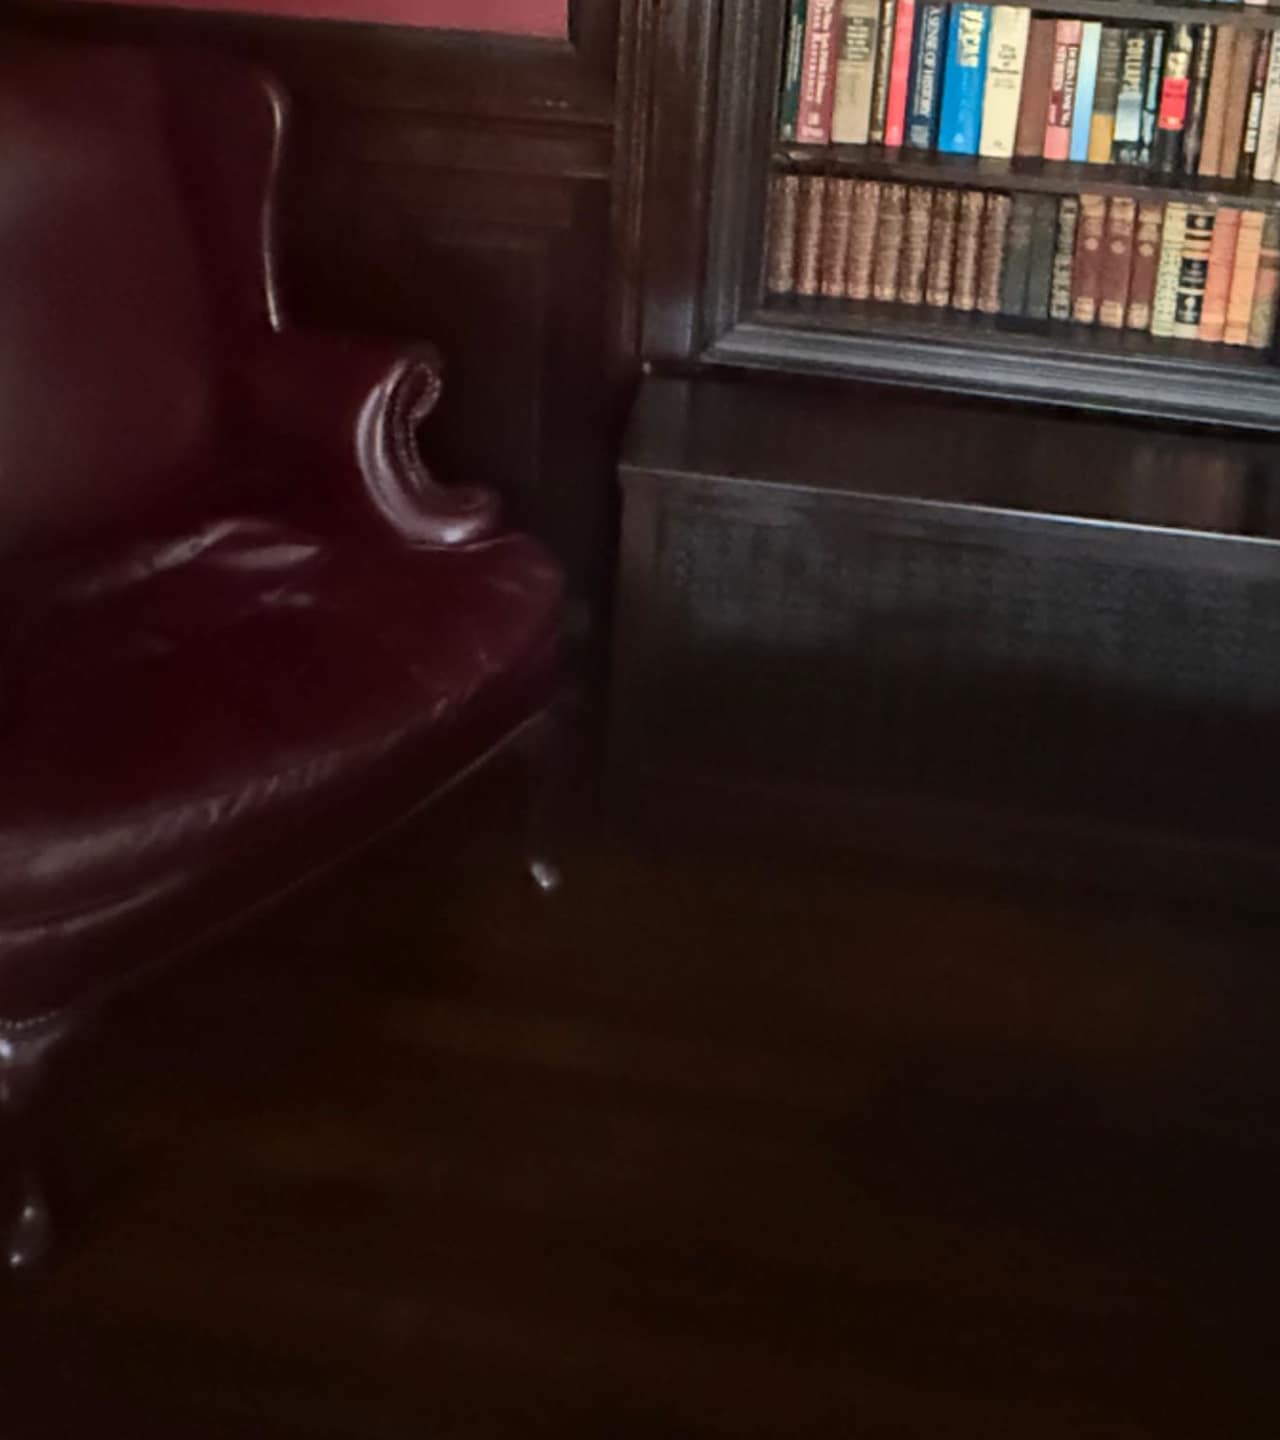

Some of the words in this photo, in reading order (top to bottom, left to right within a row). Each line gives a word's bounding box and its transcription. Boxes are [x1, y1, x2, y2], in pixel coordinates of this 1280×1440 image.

[925, 16, 941, 50] SENSE
[923, 52, 937, 70] OF
[919, 70, 936, 118] HISTORY
